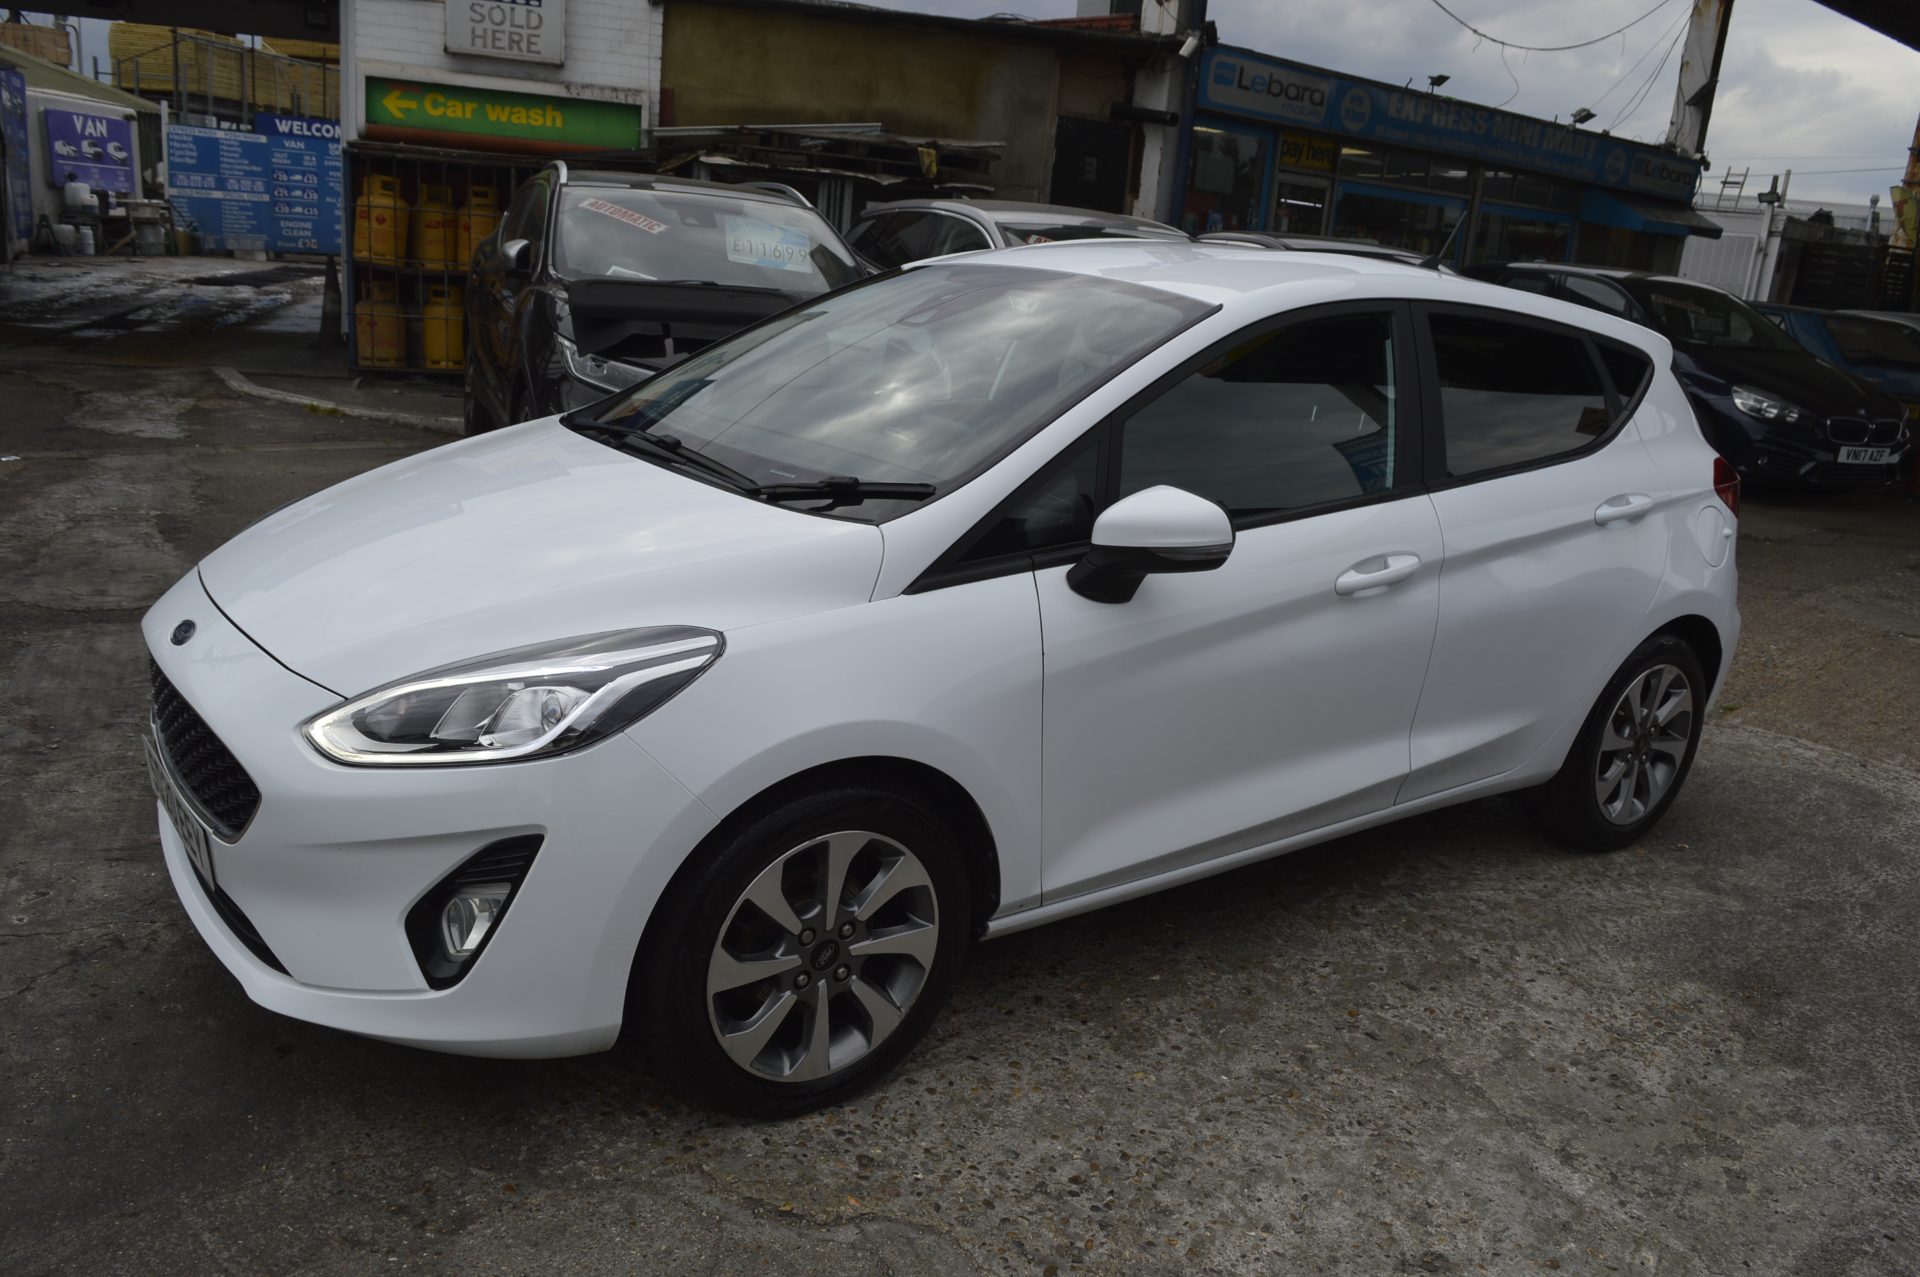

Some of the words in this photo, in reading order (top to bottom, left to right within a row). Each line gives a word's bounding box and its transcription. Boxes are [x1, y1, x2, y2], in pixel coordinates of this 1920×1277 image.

[469, 2, 544, 30] SOLD
[470, 26, 542, 55] HERE
[1237, 65, 1326, 107] Lebara
[424, 92, 477, 120] Car
[485, 103, 564, 128] wash
[72, 114, 108, 139] VAN
[1388, 90, 1488, 136] EXPRESS
[1492, 113, 1539, 148] MINI
[1542, 126, 1600, 161] MART
[283, 139, 305, 150] VAN
[1281, 139, 1304, 164] pay
[1306, 139, 1337, 162] here
[1644, 159, 1693, 186] Lebara
[280, 220, 313, 229] ENGINE
[590, 200, 661, 232] AUTOMATIC
[282, 228, 312, 237] CLEAN
